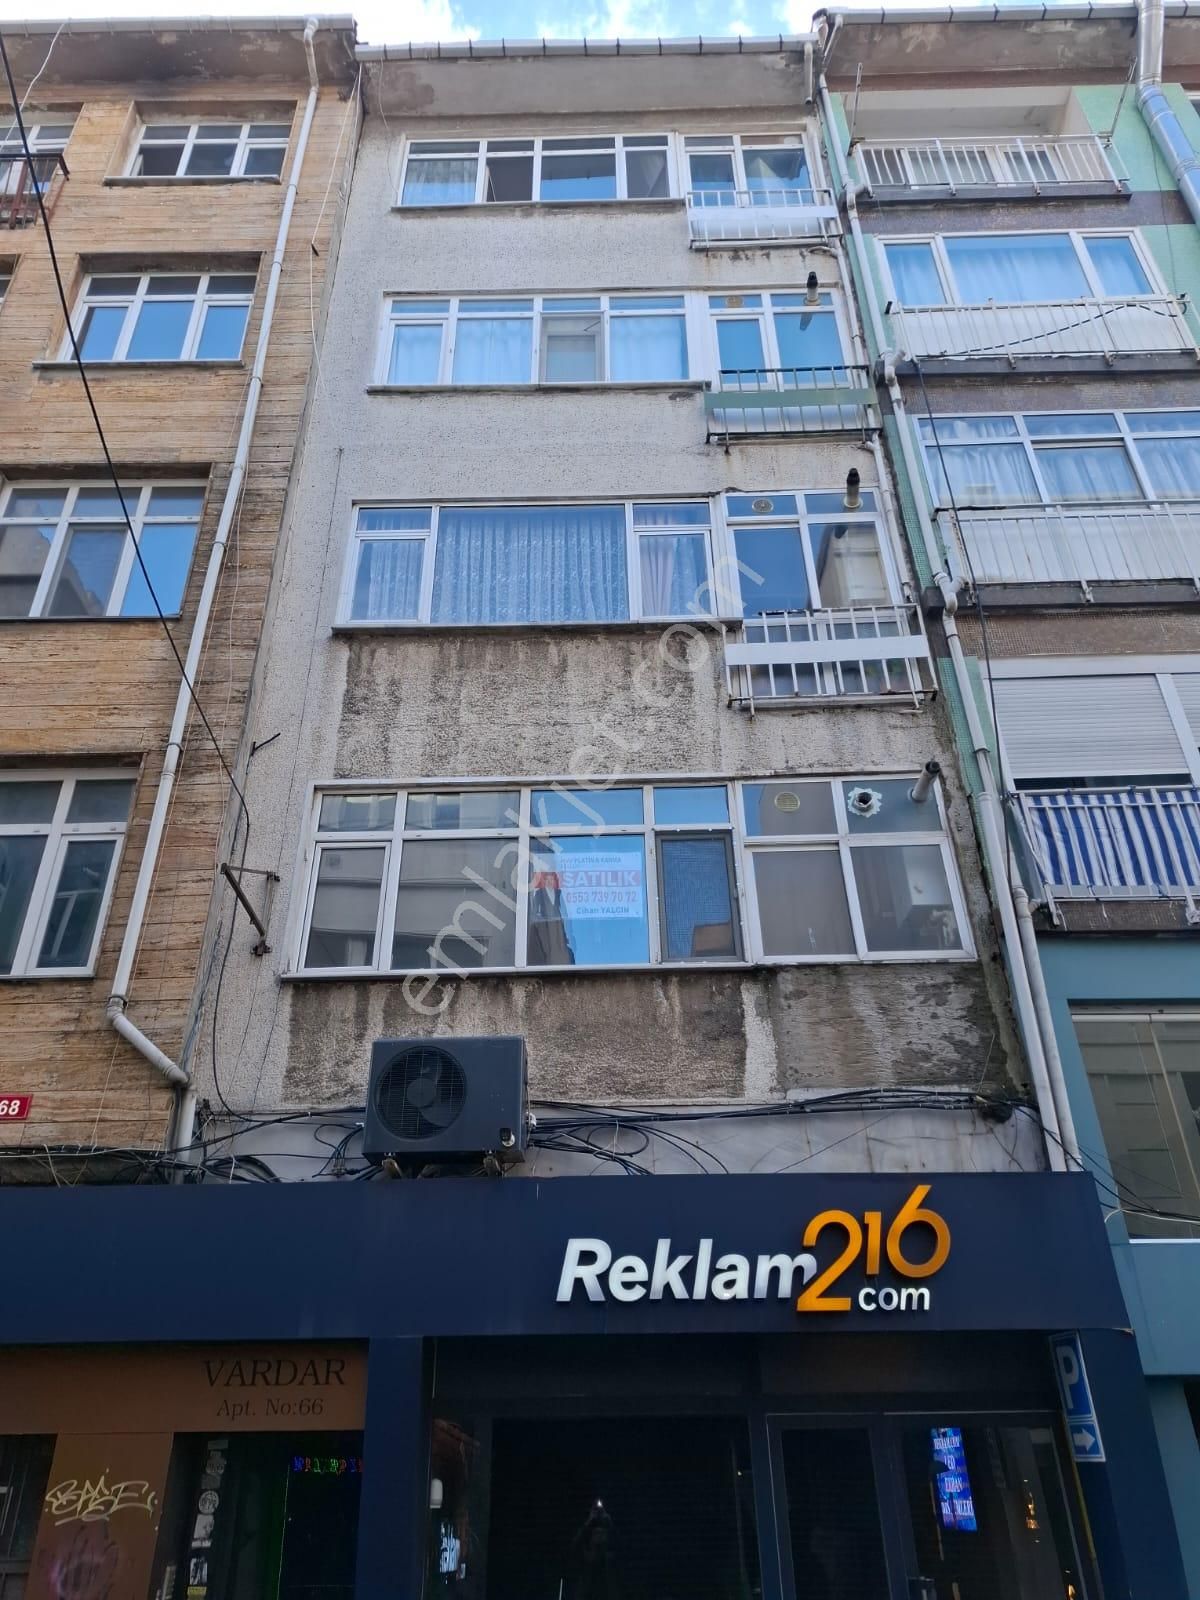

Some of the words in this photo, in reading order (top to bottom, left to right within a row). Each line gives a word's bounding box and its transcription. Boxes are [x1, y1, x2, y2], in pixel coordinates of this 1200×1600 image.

[563, 871, 637, 887] SATILIK
[0, 1099, 21, 1116] 68
[858, 1287, 931, 1311] com
[202, 1359, 346, 1387] VARDAR
[1056, 1345, 1080, 1409] P
[216, 1399, 257, 1421] Apt.
[265, 1398, 324, 1416] No:66
